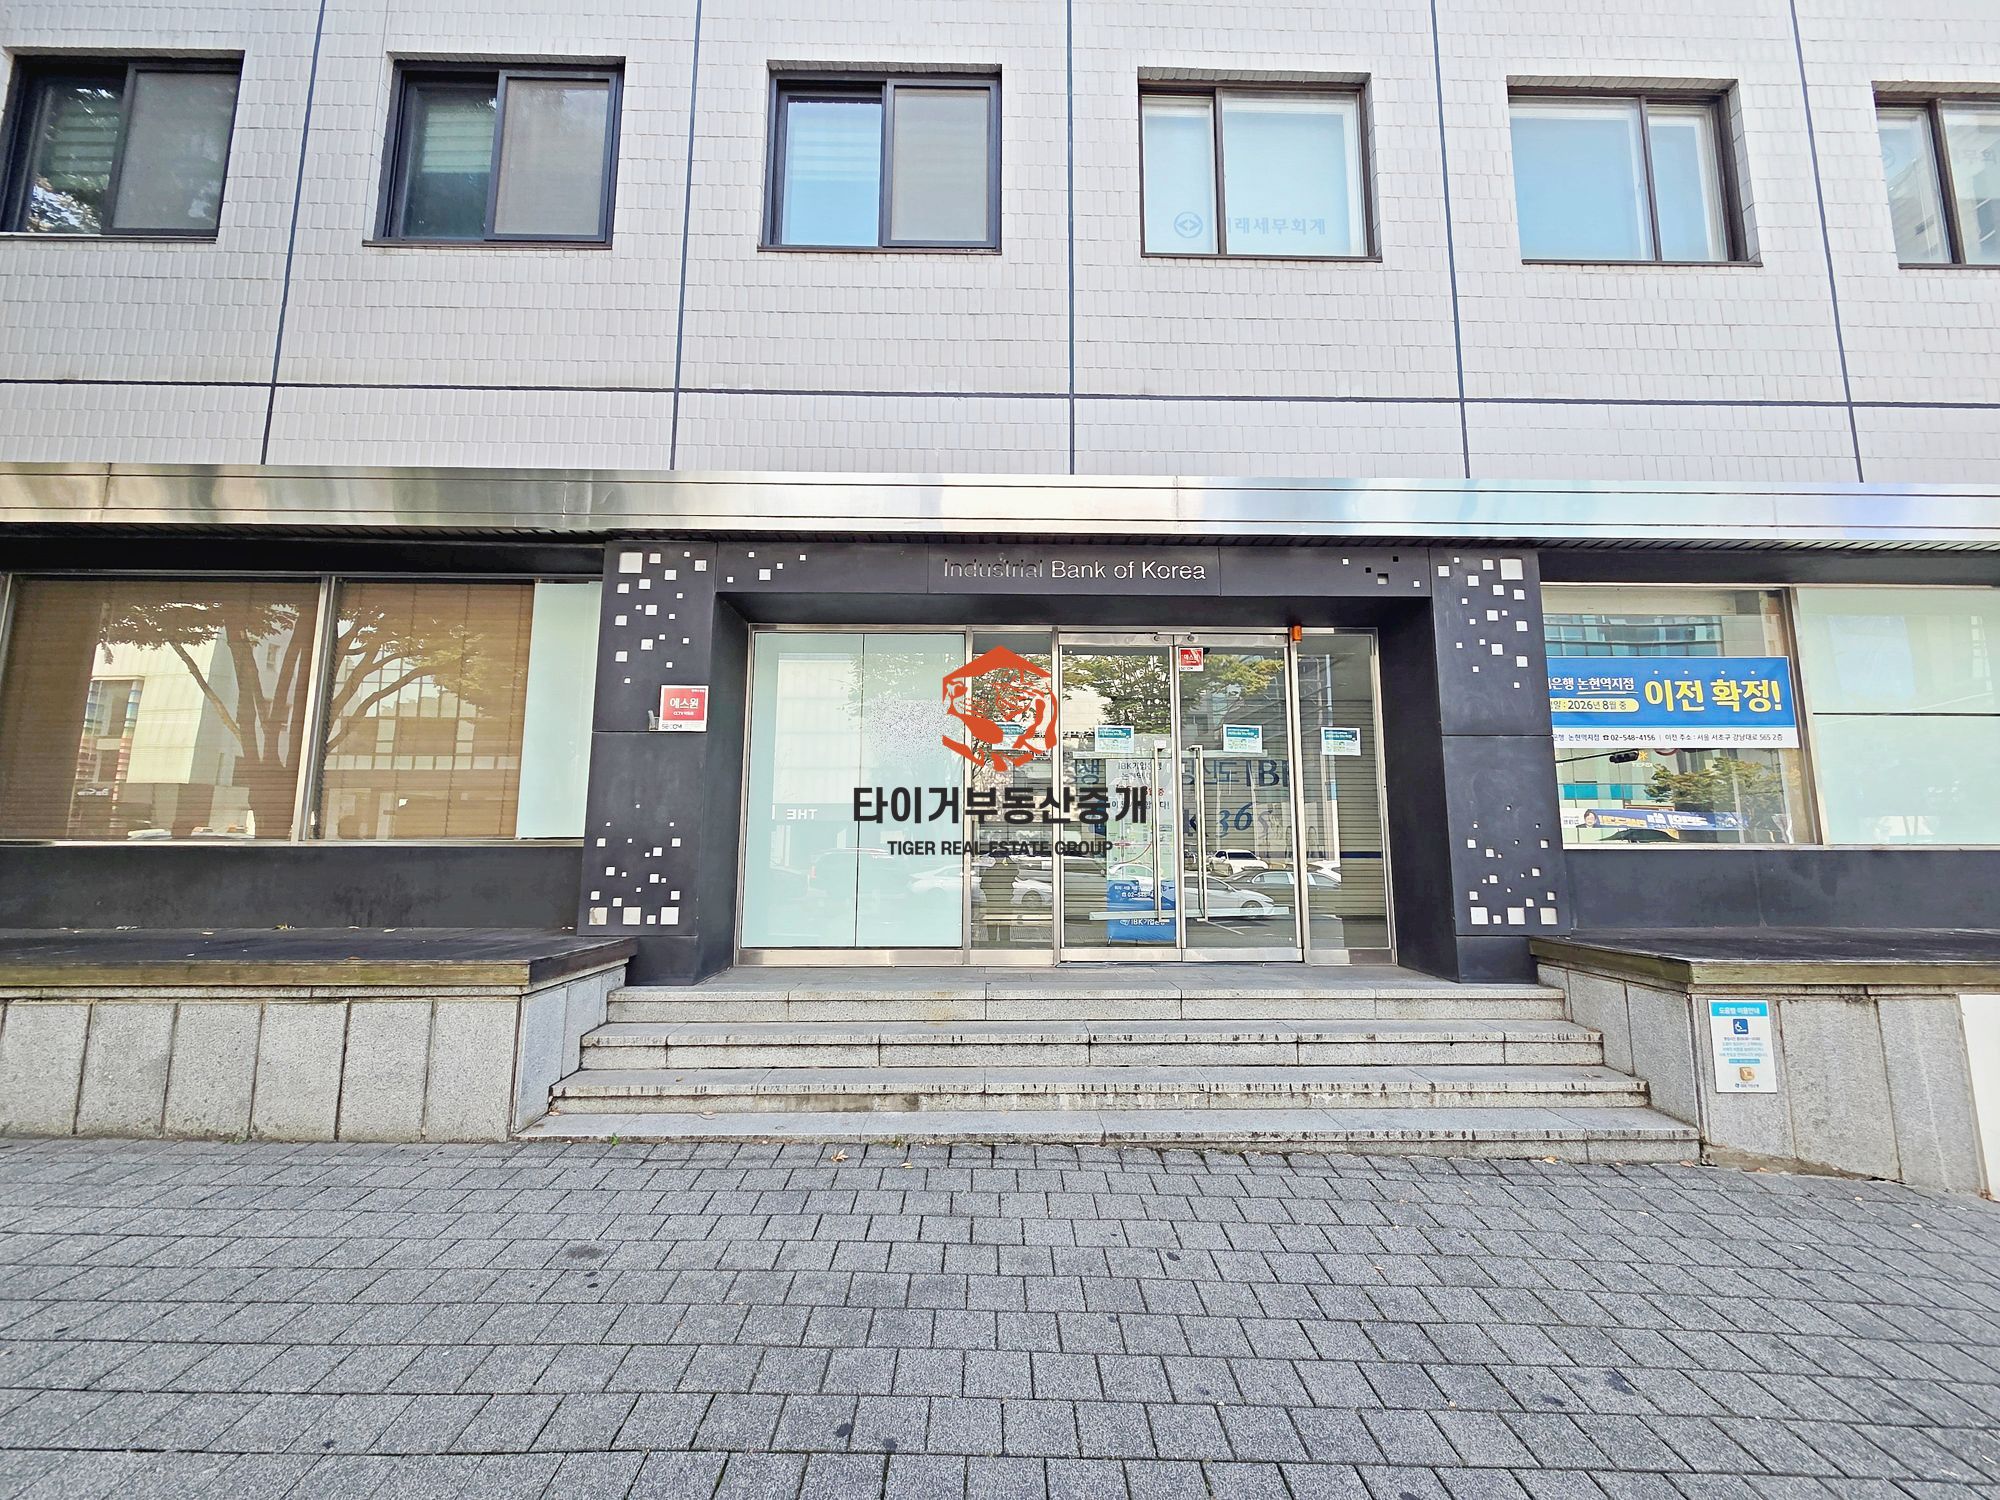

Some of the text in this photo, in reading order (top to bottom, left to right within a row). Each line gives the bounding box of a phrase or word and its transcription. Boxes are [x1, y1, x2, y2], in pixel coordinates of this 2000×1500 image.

[943, 558, 1206, 580] Industrial Bank of Korea
[1548, 677, 1635, 691] 은행 논현역지점
[1644, 678, 1783, 713] 이전 확정!
[669, 697, 699, 709] 에스원
[1567, 700, 1601, 711] 2026년
[1602, 700, 1617, 711] 8월
[1568, 734, 1600, 742] 논현역지점
[1610, 734, 1656, 742] 02-548-4156
